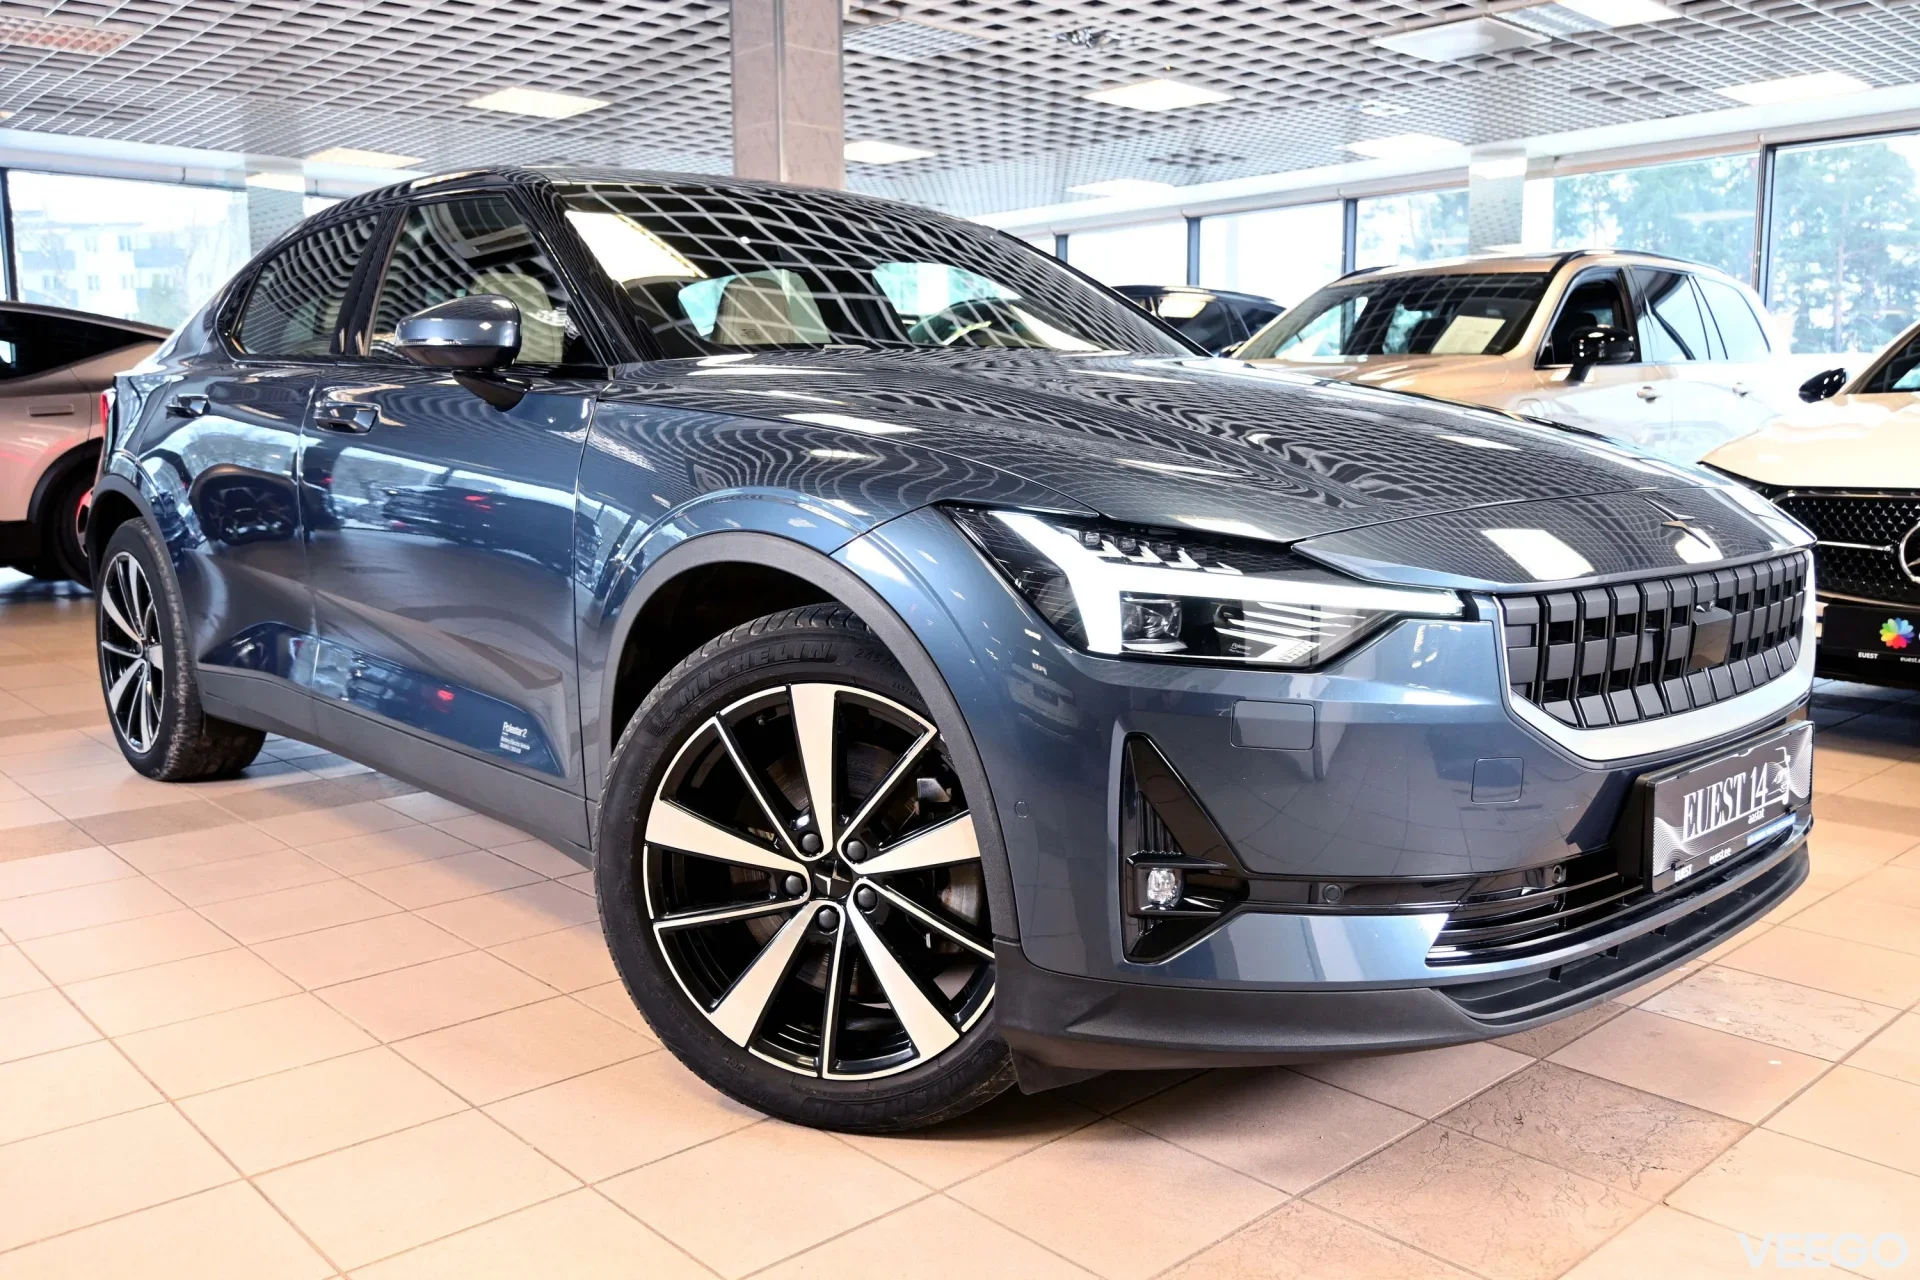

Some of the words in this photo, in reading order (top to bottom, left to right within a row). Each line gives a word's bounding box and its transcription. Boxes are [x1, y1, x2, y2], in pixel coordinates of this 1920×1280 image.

[679, 641, 833, 706] MICHELIN
[502, 721, 521, 736] Polestar
[521, 728, 528, 738] 2
[1682, 771, 1747, 843] EUEST
[1750, 762, 1769, 810] 14
[1709, 847, 1731, 865] euest.ee
[1674, 864, 1693, 882] EUEST
